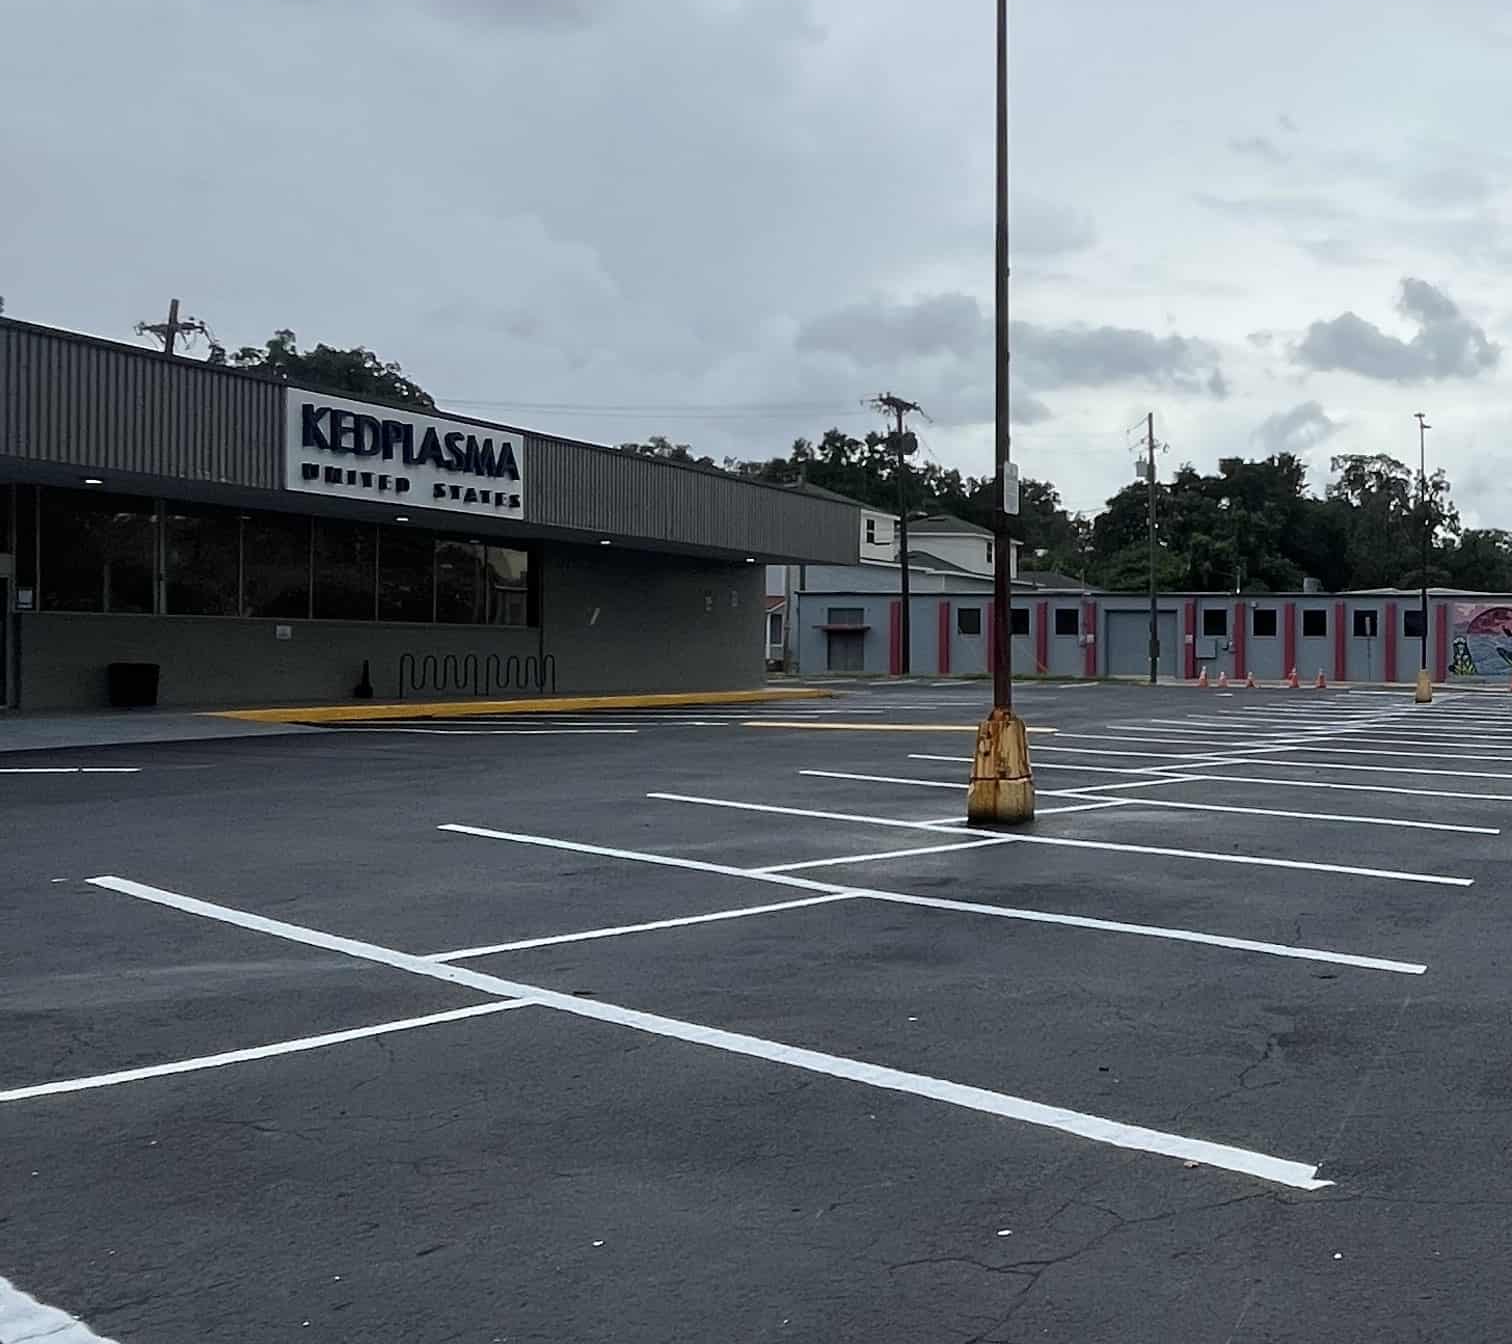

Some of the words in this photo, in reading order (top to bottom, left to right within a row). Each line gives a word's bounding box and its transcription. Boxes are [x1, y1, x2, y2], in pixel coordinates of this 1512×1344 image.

[301, 404, 520, 480] KEDPLASMA
[302, 463, 410, 492] UNITED
[433, 483, 521, 508] STATES
